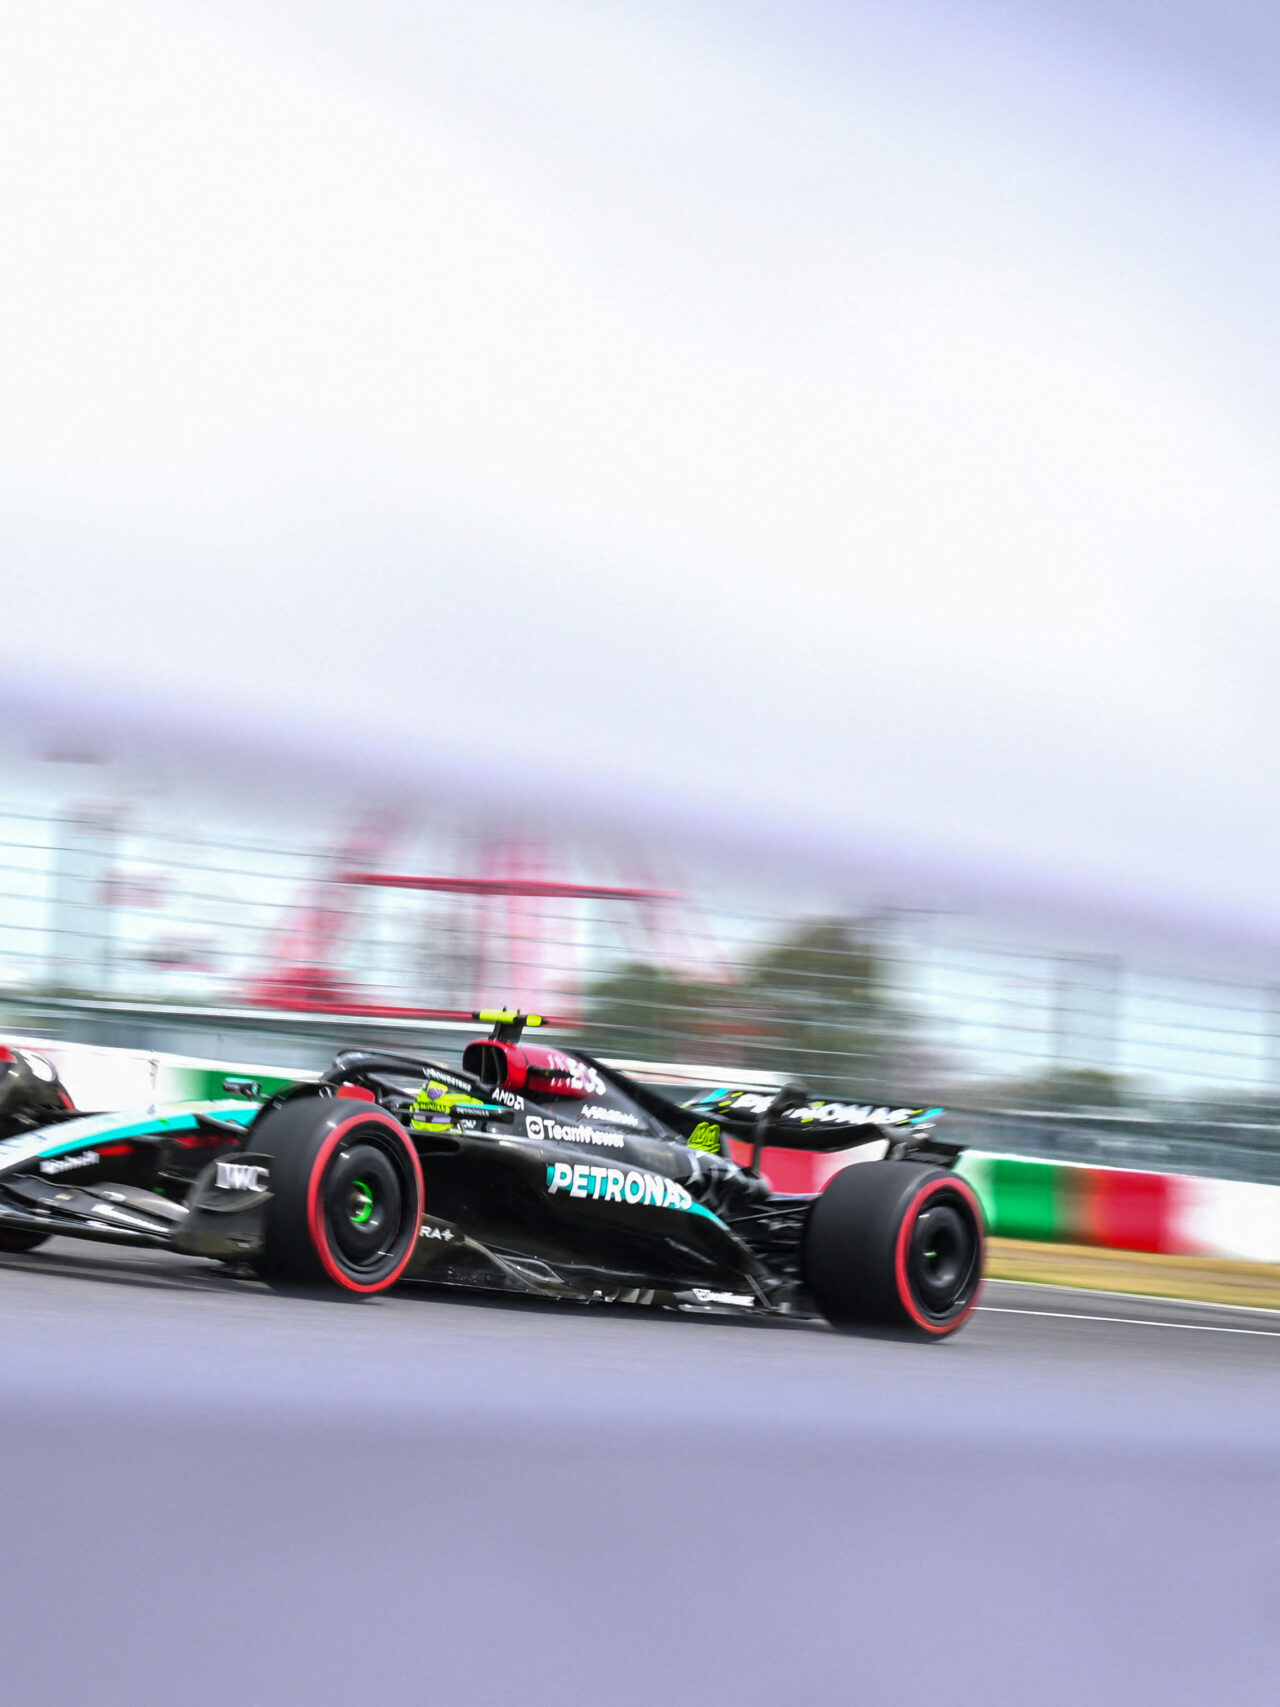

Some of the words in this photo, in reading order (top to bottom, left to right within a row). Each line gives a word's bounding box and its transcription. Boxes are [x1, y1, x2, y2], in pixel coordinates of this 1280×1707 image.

[492, 1087, 515, 1107] AMD
[215, 1162, 270, 1192] IWC
[548, 1162, 693, 1210] PETRONAS
